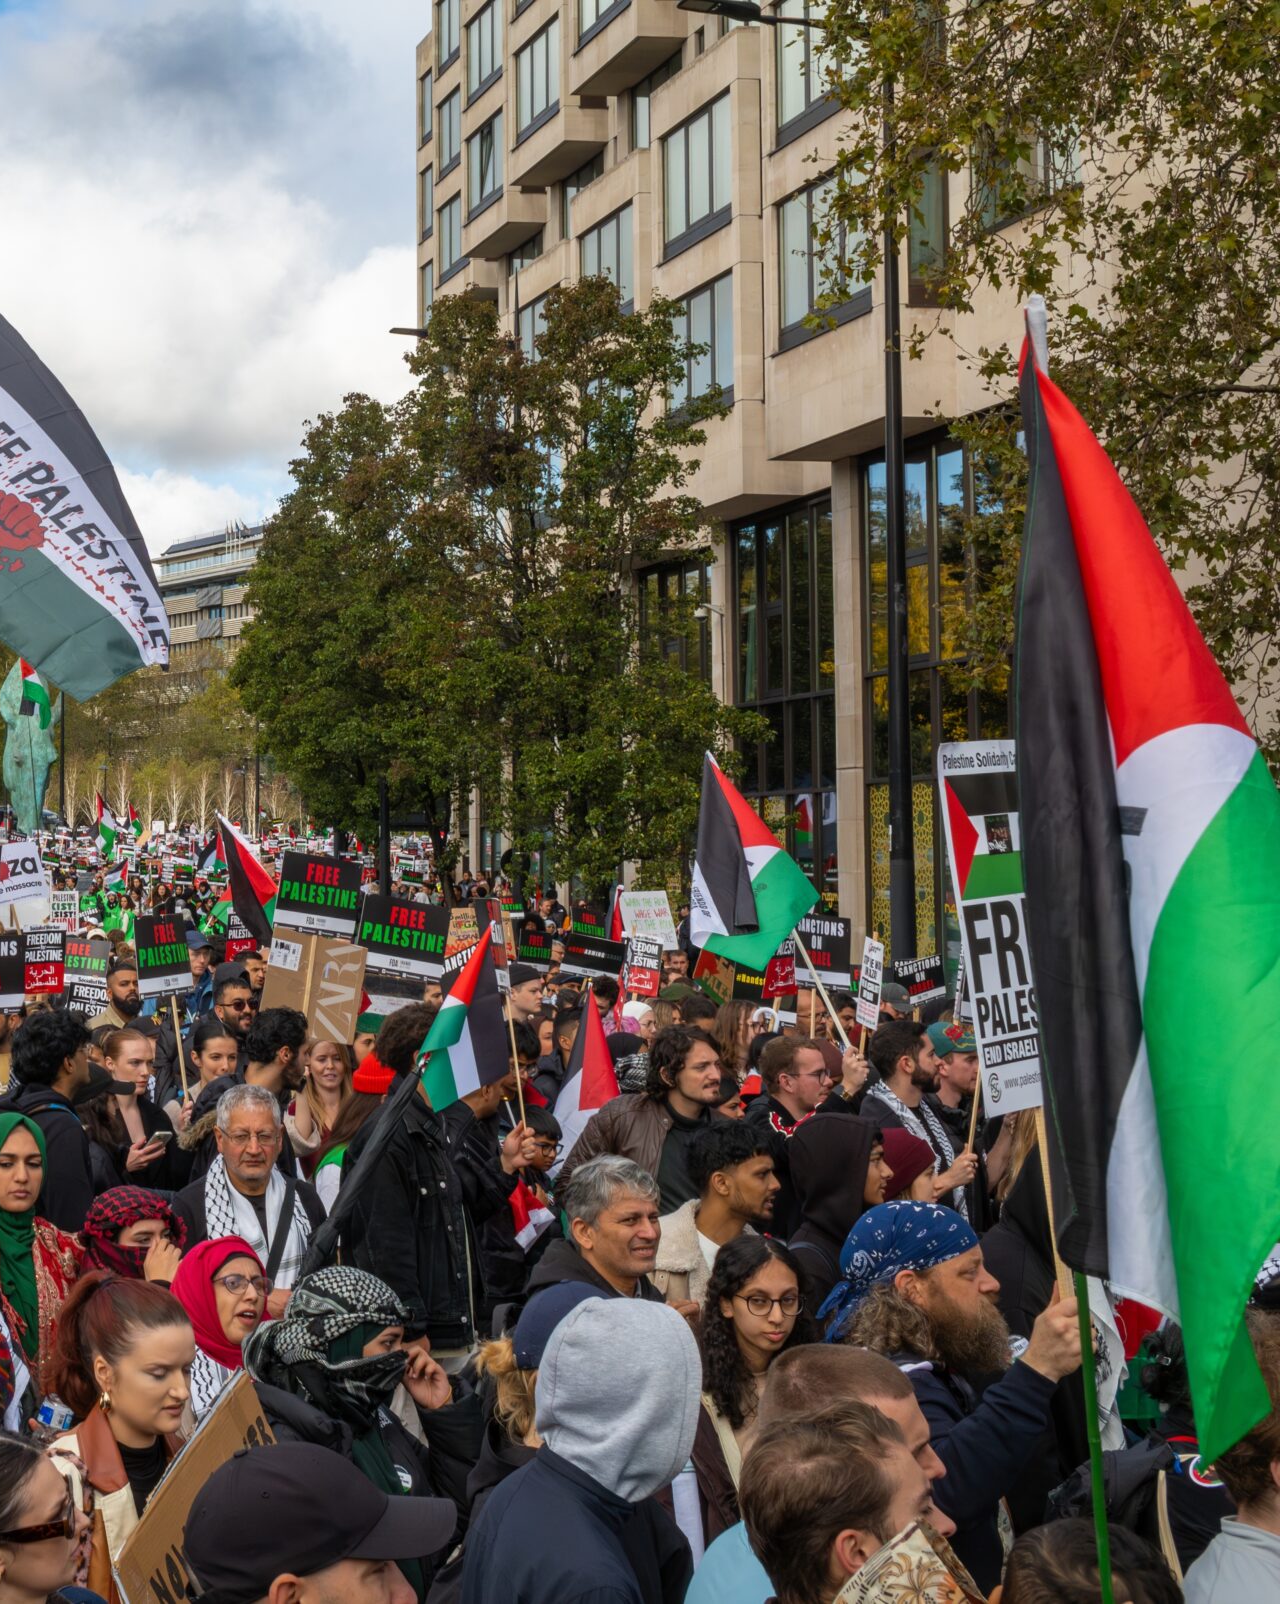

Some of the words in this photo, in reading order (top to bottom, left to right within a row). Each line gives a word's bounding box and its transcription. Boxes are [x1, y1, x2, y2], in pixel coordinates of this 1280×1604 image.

[10, 462, 169, 650] PALESTINE
[942, 754, 975, 770] Palestine
[975, 750, 1009, 769] Solidarity
[10, 857, 39, 878] za
[306, 863, 340, 886] FREE
[5, 880, 42, 893] massacre
[281, 879, 358, 909] PALESTINE
[390, 906, 426, 930] FREE
[653, 907, 670, 918] WAR
[153, 922, 176, 944] FREE
[573, 921, 605, 937] PALESTINE
[798, 918, 845, 937] SANCTIONS
[26, 933, 62, 946] FREEDOM
[361, 922, 445, 954] PALESTINE
[528, 934, 544, 947] FREE
[811, 935, 823, 950] ON
[962, 899, 1028, 993] FR
[25, 949, 63, 962] PALESTINE
[65, 943, 91, 956] FREE
[138, 943, 189, 968] PALESTIN
[29, 966, 54, 978] الحرية
[64, 955, 107, 971] ESTINE
[898, 956, 941, 977] SANCTIONS
[25, 976, 58, 989] لفلسطين
[915, 971, 926, 982] ON
[73, 984, 109, 1001] FREEDO
[311, 945, 364, 1044] ZARA
[976, 987, 1039, 1040] PALES
[984, 1045, 1002, 1066] END
[1003, 1037, 1039, 1061] ISRAELI
